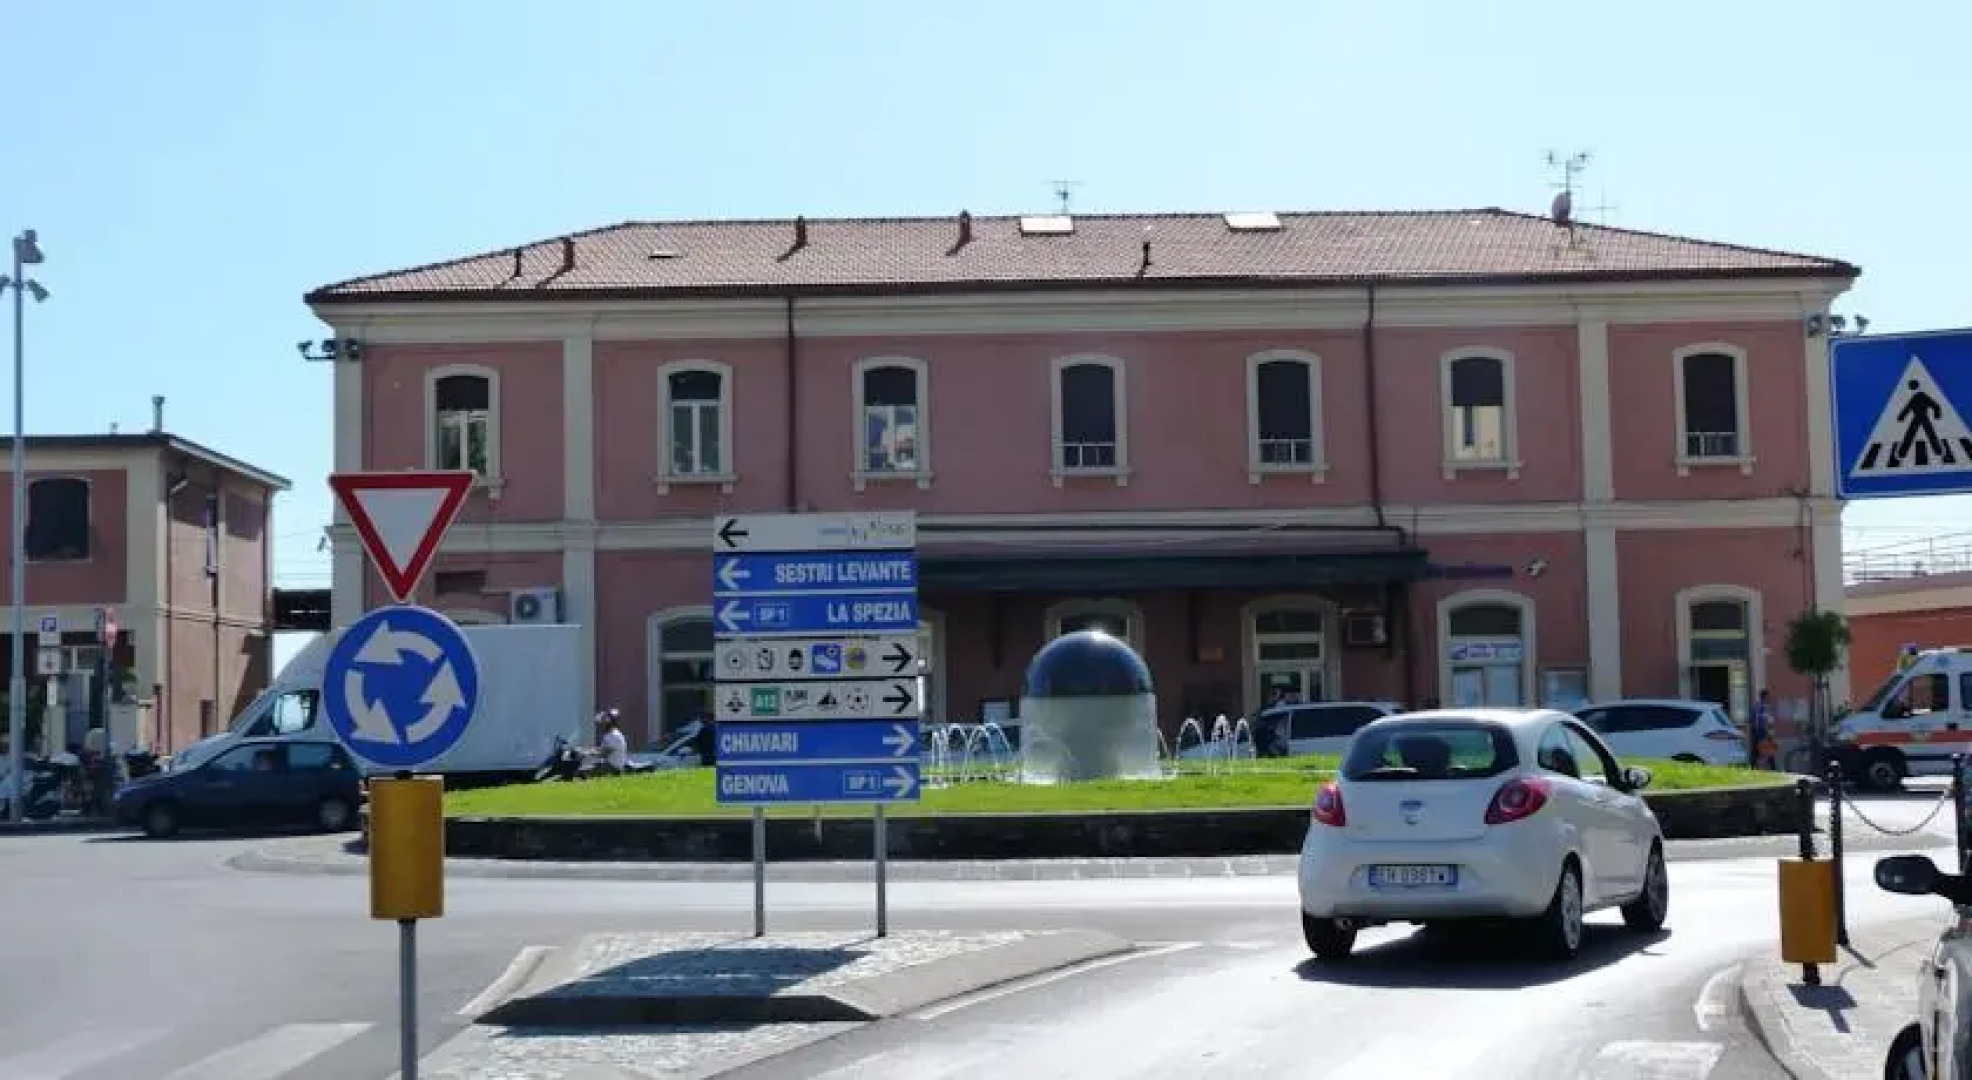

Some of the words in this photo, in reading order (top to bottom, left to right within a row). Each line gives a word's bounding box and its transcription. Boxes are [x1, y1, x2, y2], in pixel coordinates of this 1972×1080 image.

[774, 563, 832, 583] SESTRI
[837, 561, 912, 581] LEVANTE
[827, 603, 848, 623] LA
[853, 601, 912, 622] SPEZIA
[720, 732, 798, 752] CHIAVARI
[722, 774, 789, 794] GENOVA
